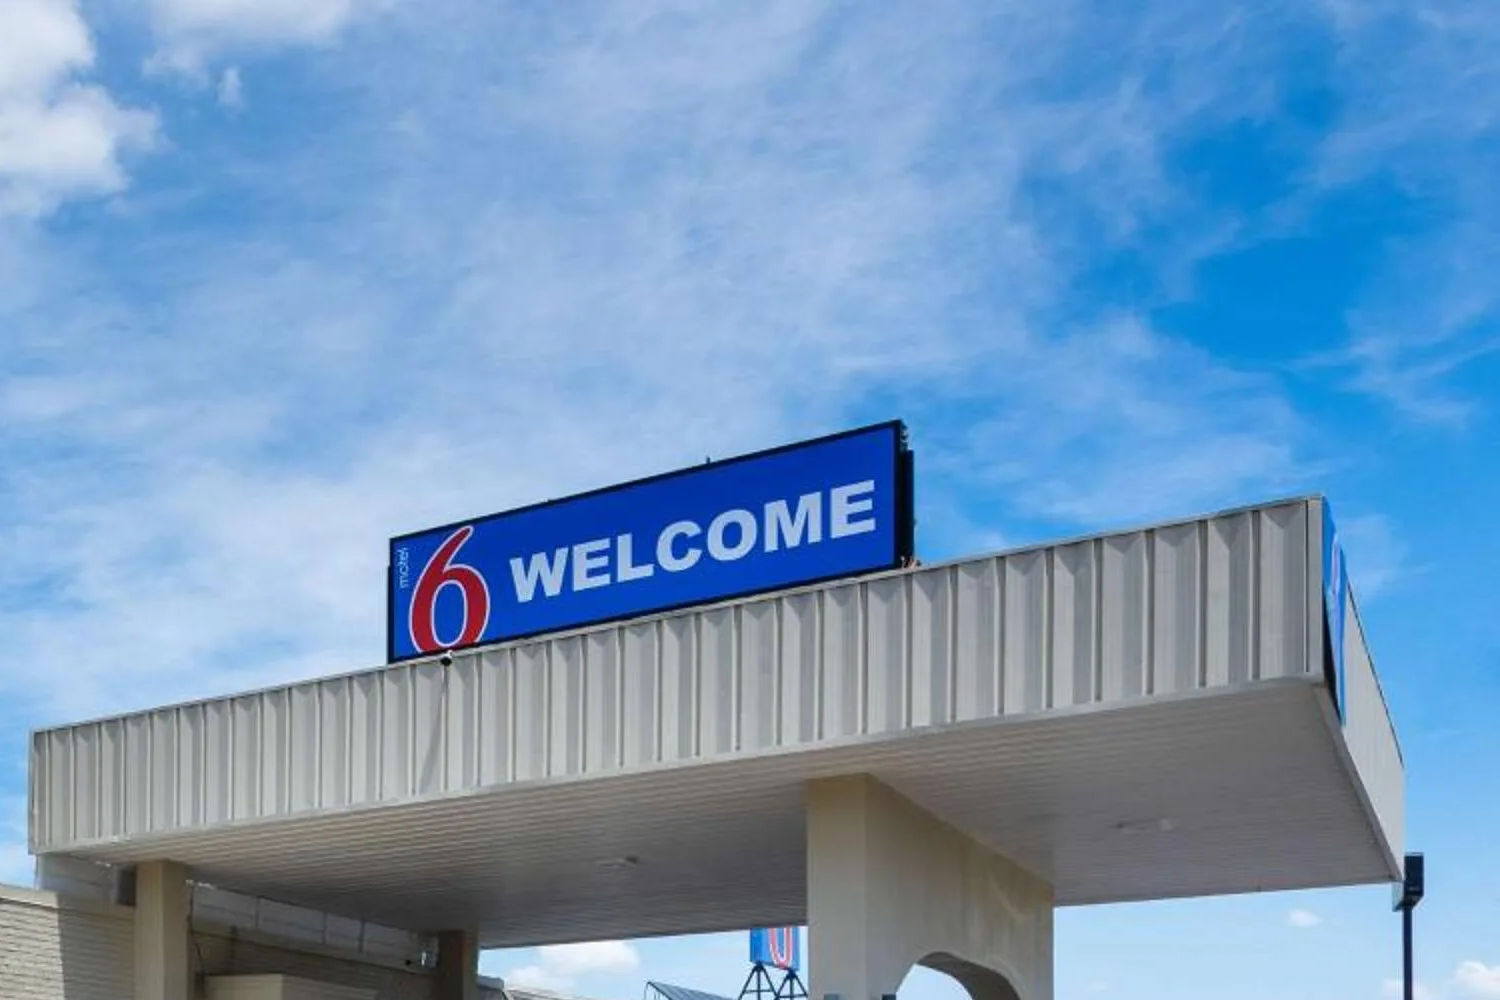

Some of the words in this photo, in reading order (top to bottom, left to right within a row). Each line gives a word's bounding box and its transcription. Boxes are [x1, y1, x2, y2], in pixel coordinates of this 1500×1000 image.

[397, 546, 410, 589] motel
[408, 525, 491, 653] 6
[509, 479, 876, 604] WELCOME
